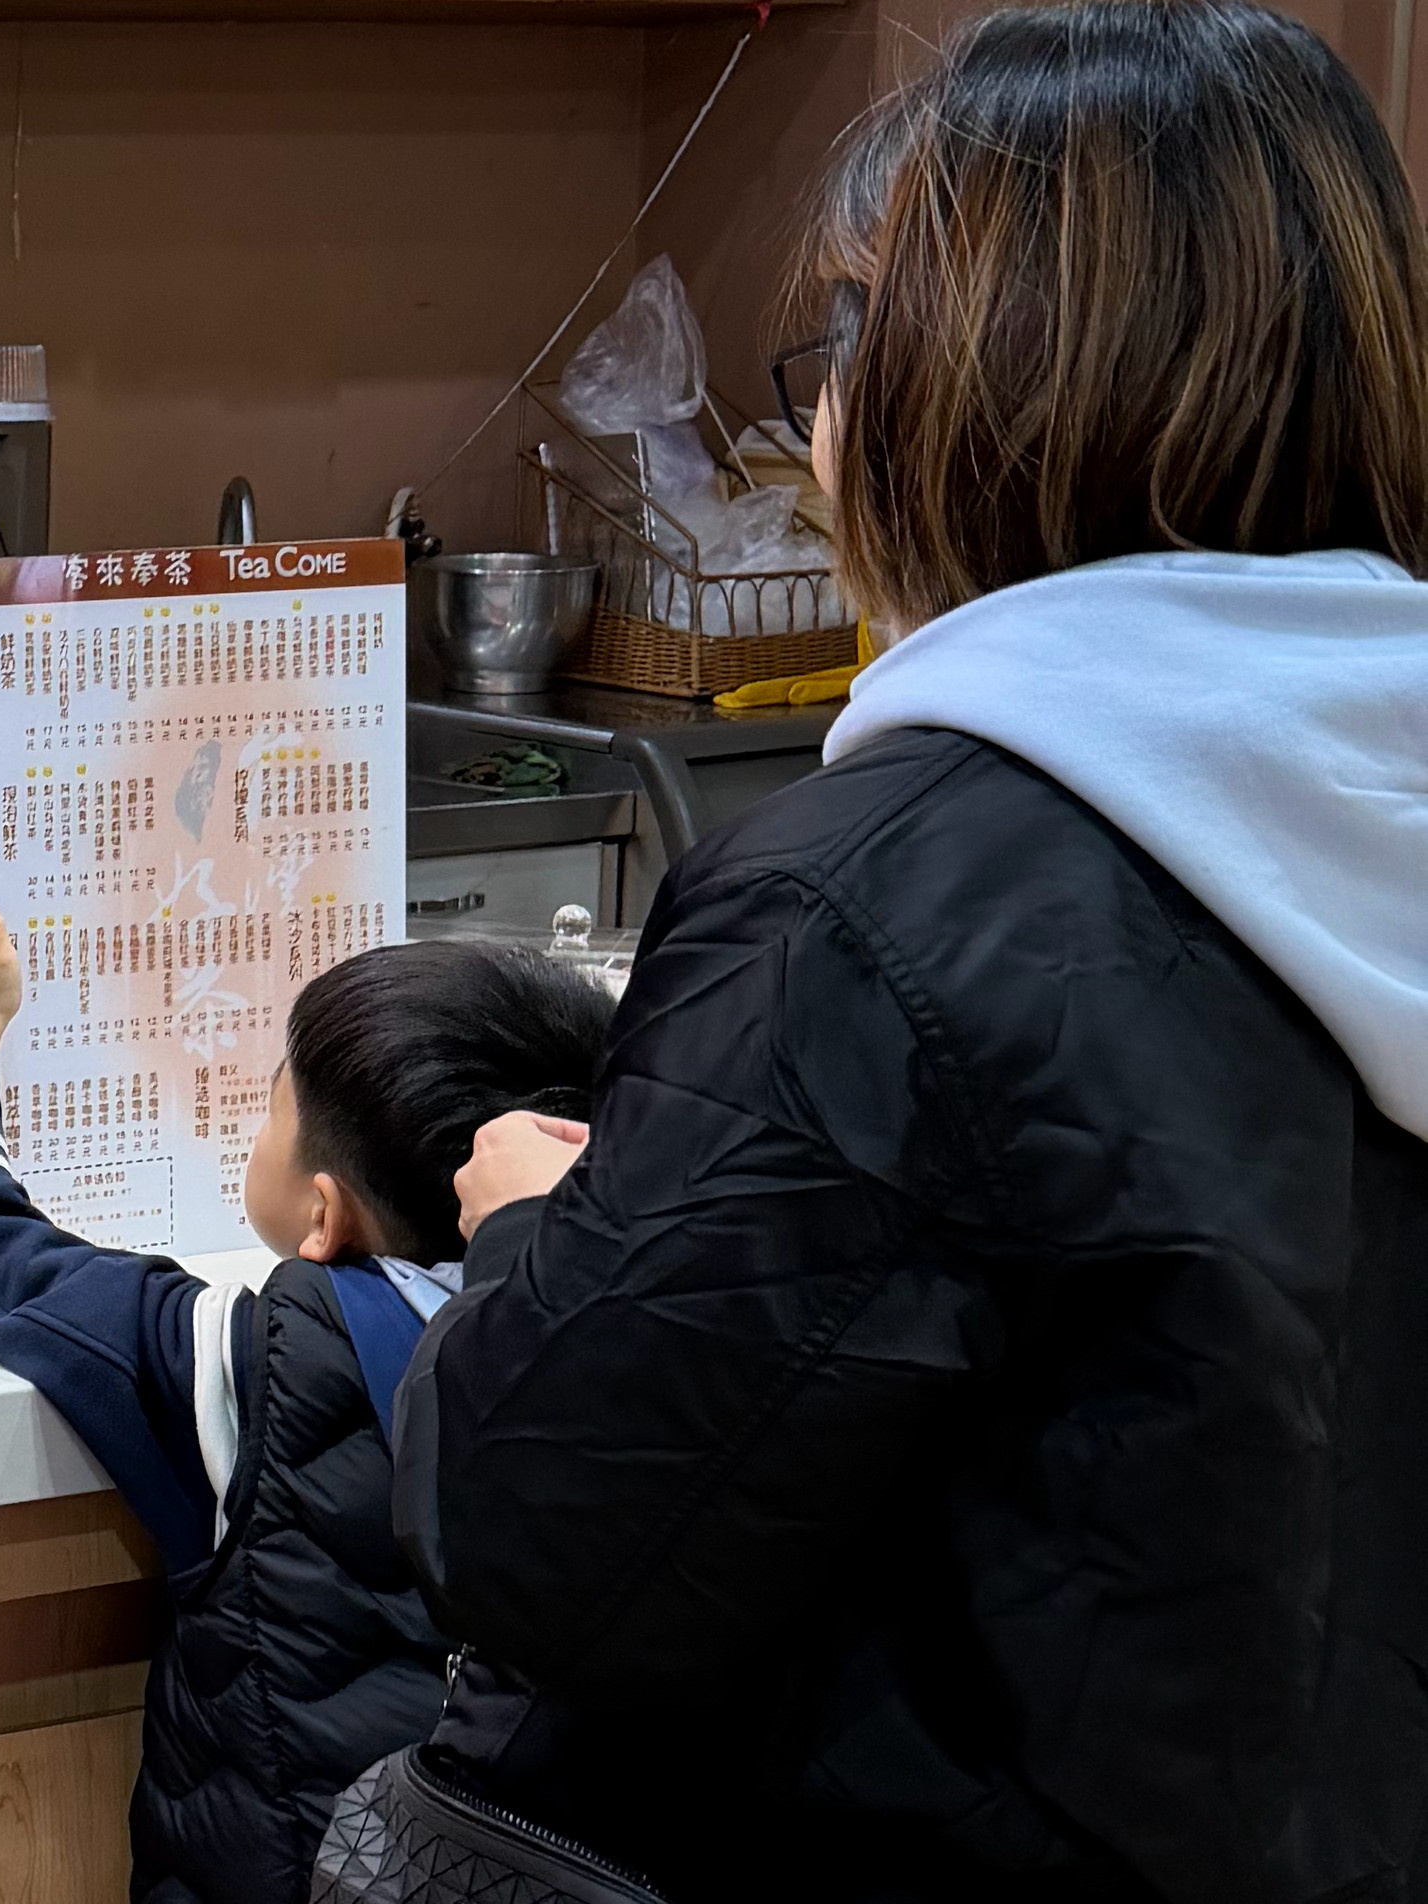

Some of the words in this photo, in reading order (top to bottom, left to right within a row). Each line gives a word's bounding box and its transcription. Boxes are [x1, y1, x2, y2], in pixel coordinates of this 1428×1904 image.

[65, 551, 192, 591] 客來奉茶
[220, 548, 272, 581] Tea
